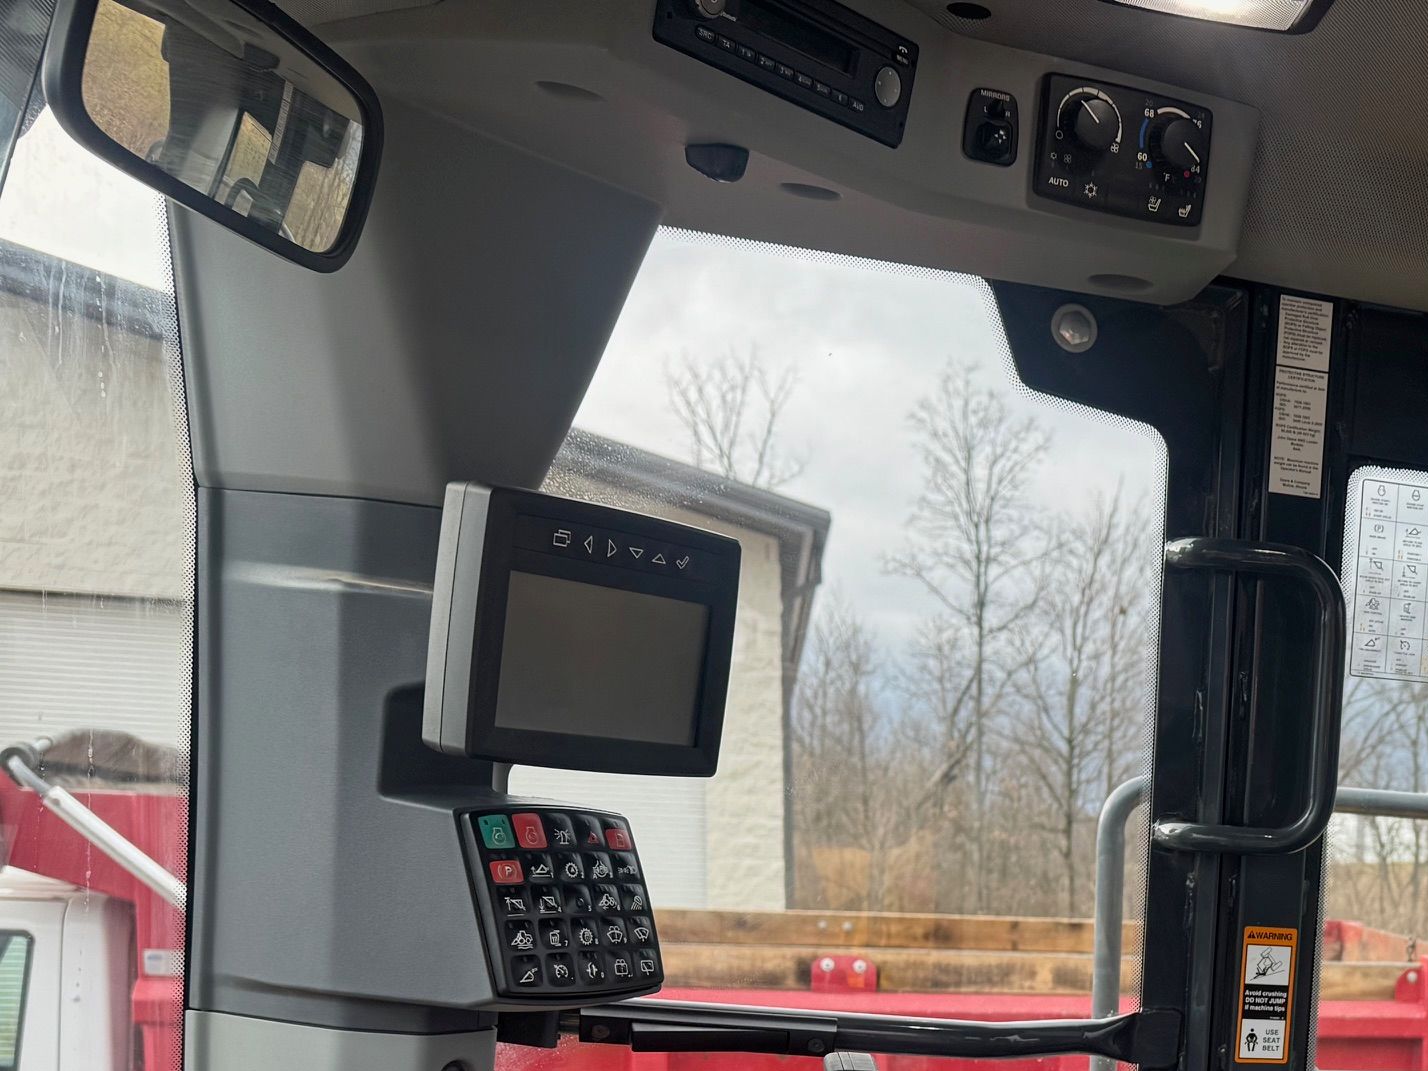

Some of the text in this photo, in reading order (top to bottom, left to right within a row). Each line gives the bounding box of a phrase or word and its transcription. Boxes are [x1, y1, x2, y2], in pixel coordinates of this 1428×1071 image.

[980, 89, 1010, 102] MIRRORS
[1144, 109, 1155, 118] 68
[1137, 153, 1147, 161] 60
[1048, 176, 1069, 187] AUTO
[1256, 932, 1292, 940] WARNING
